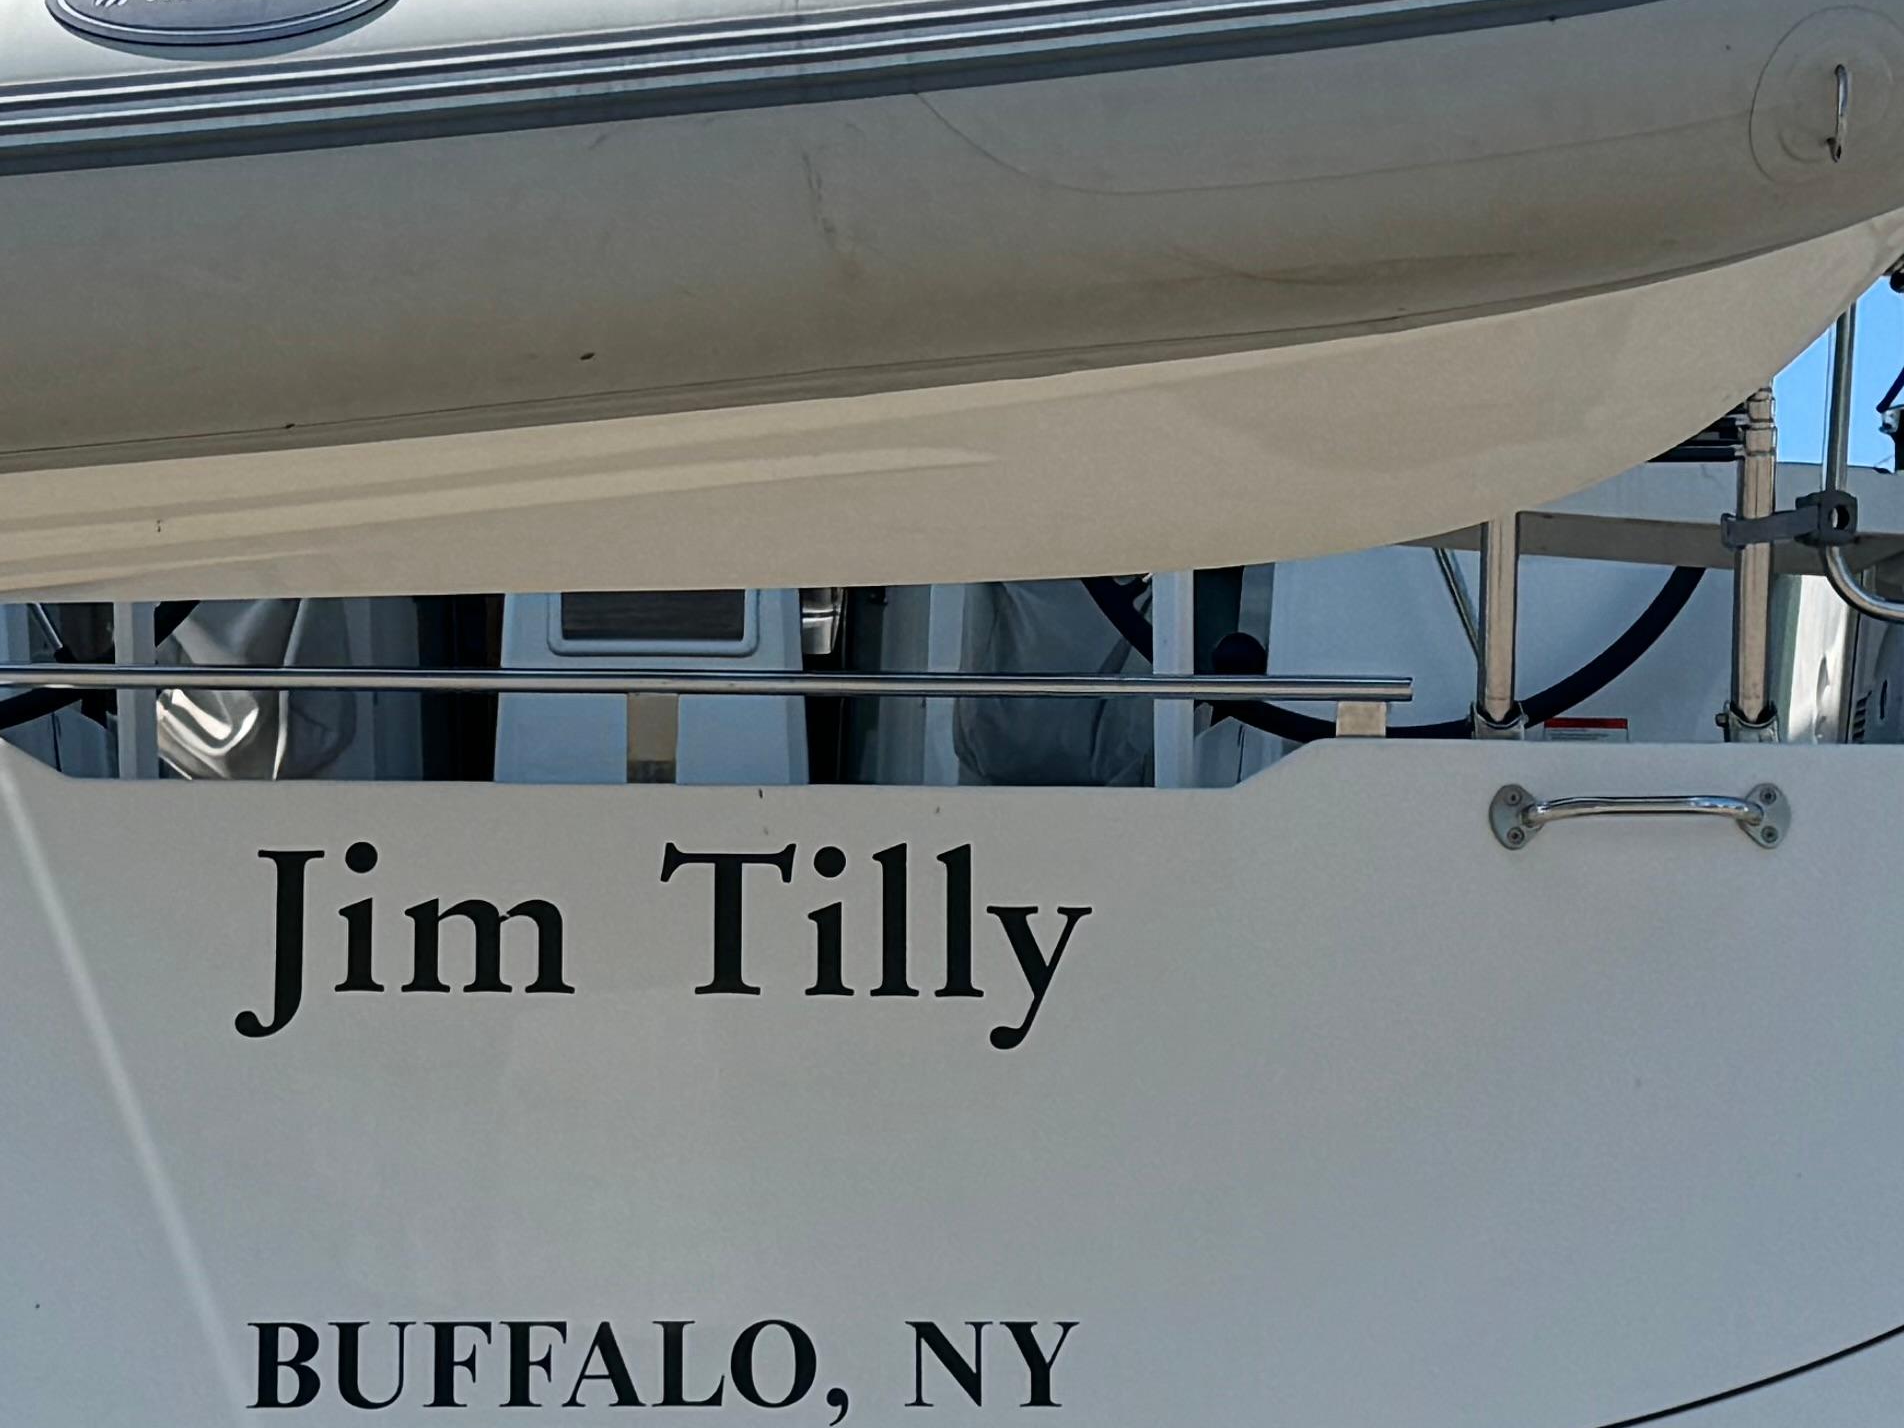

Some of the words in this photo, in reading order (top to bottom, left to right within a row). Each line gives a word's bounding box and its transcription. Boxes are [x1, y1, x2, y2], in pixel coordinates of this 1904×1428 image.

[234, 841, 576, 1038] Jim
[660, 842, 1093, 1050] Tilly
[246, 1320, 849, 1427] BUFFALO,
[904, 1320, 1080, 1408] NY
